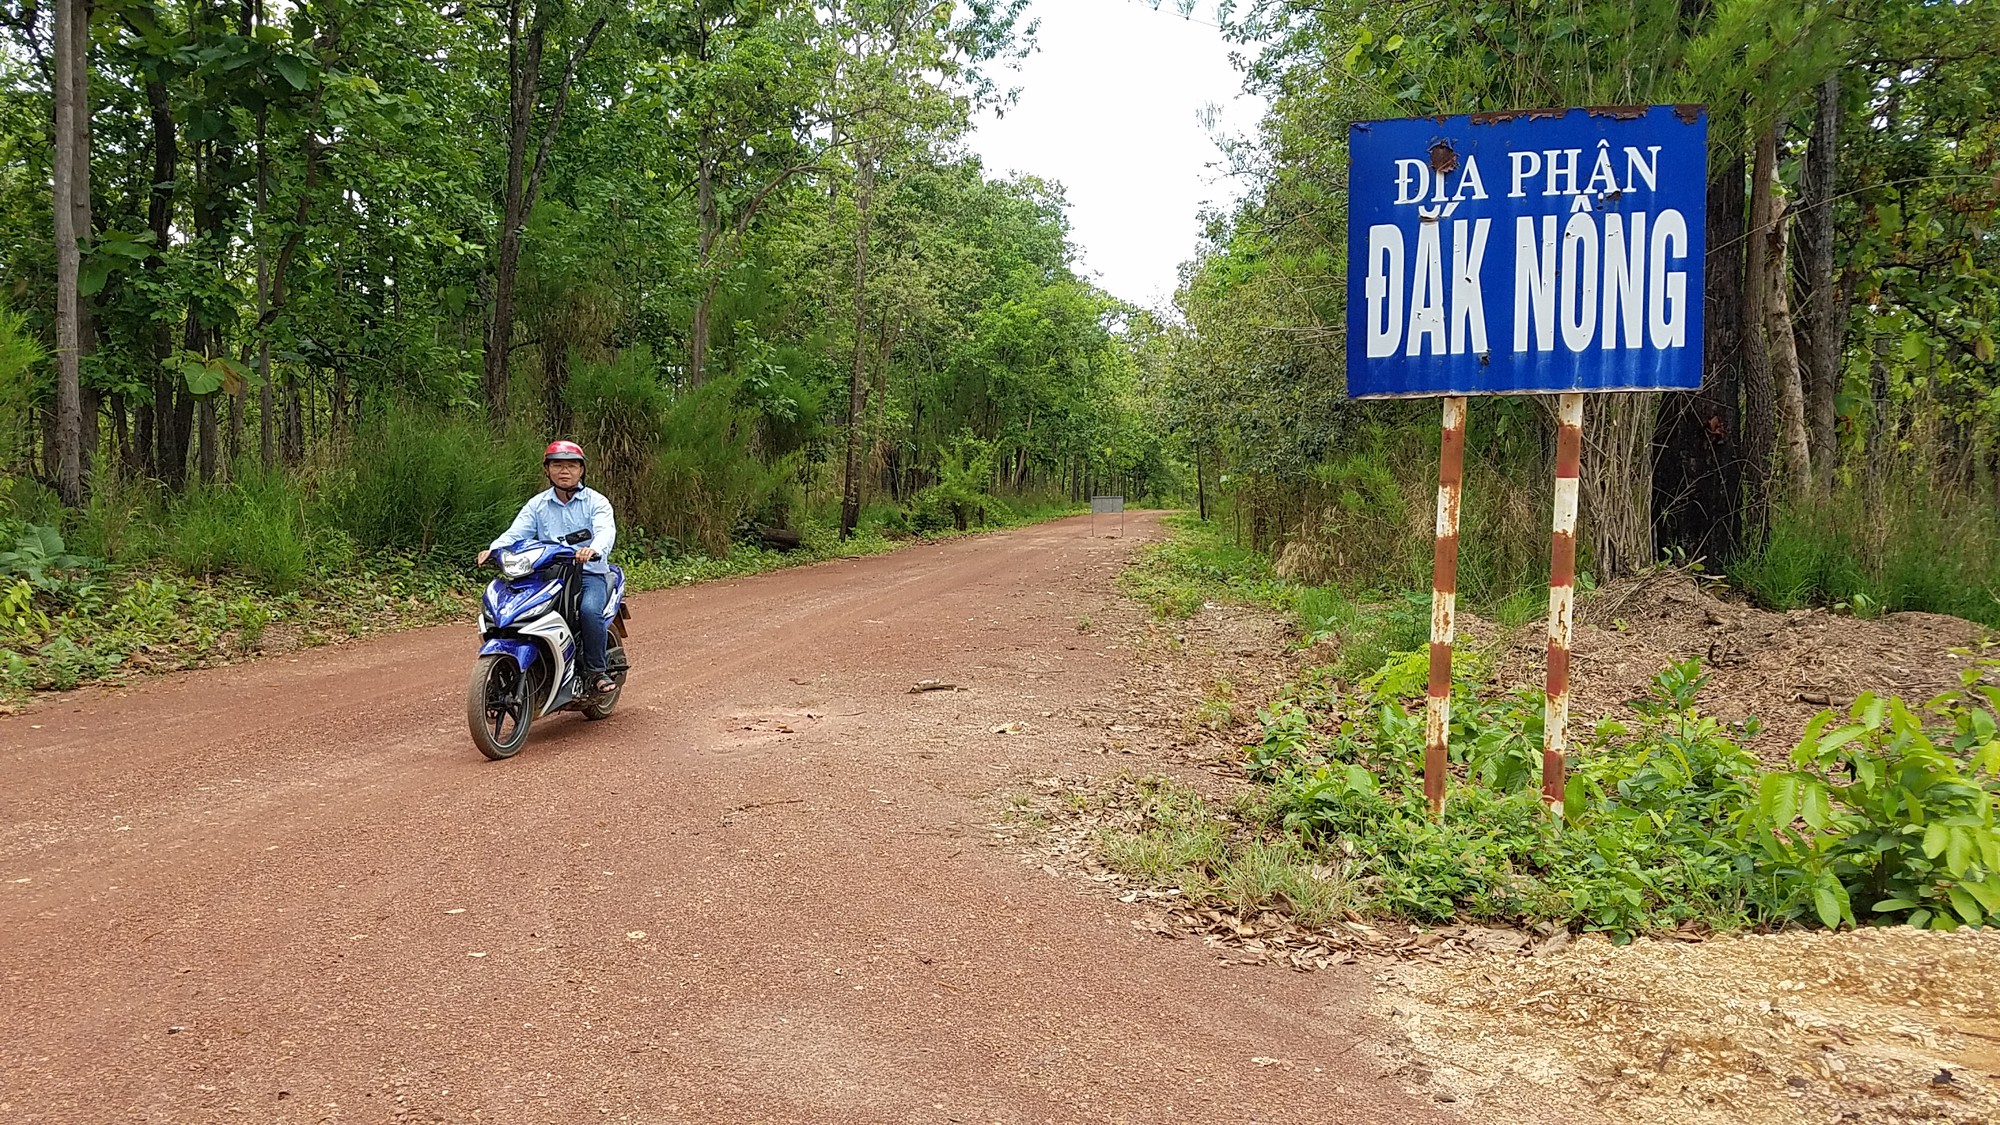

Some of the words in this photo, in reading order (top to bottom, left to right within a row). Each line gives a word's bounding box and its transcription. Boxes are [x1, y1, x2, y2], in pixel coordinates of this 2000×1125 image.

[1507, 138, 1662, 200] PHẬN
[1365, 201, 1492, 359] ĐẮK
[1513, 194, 1688, 353] NÔNG
